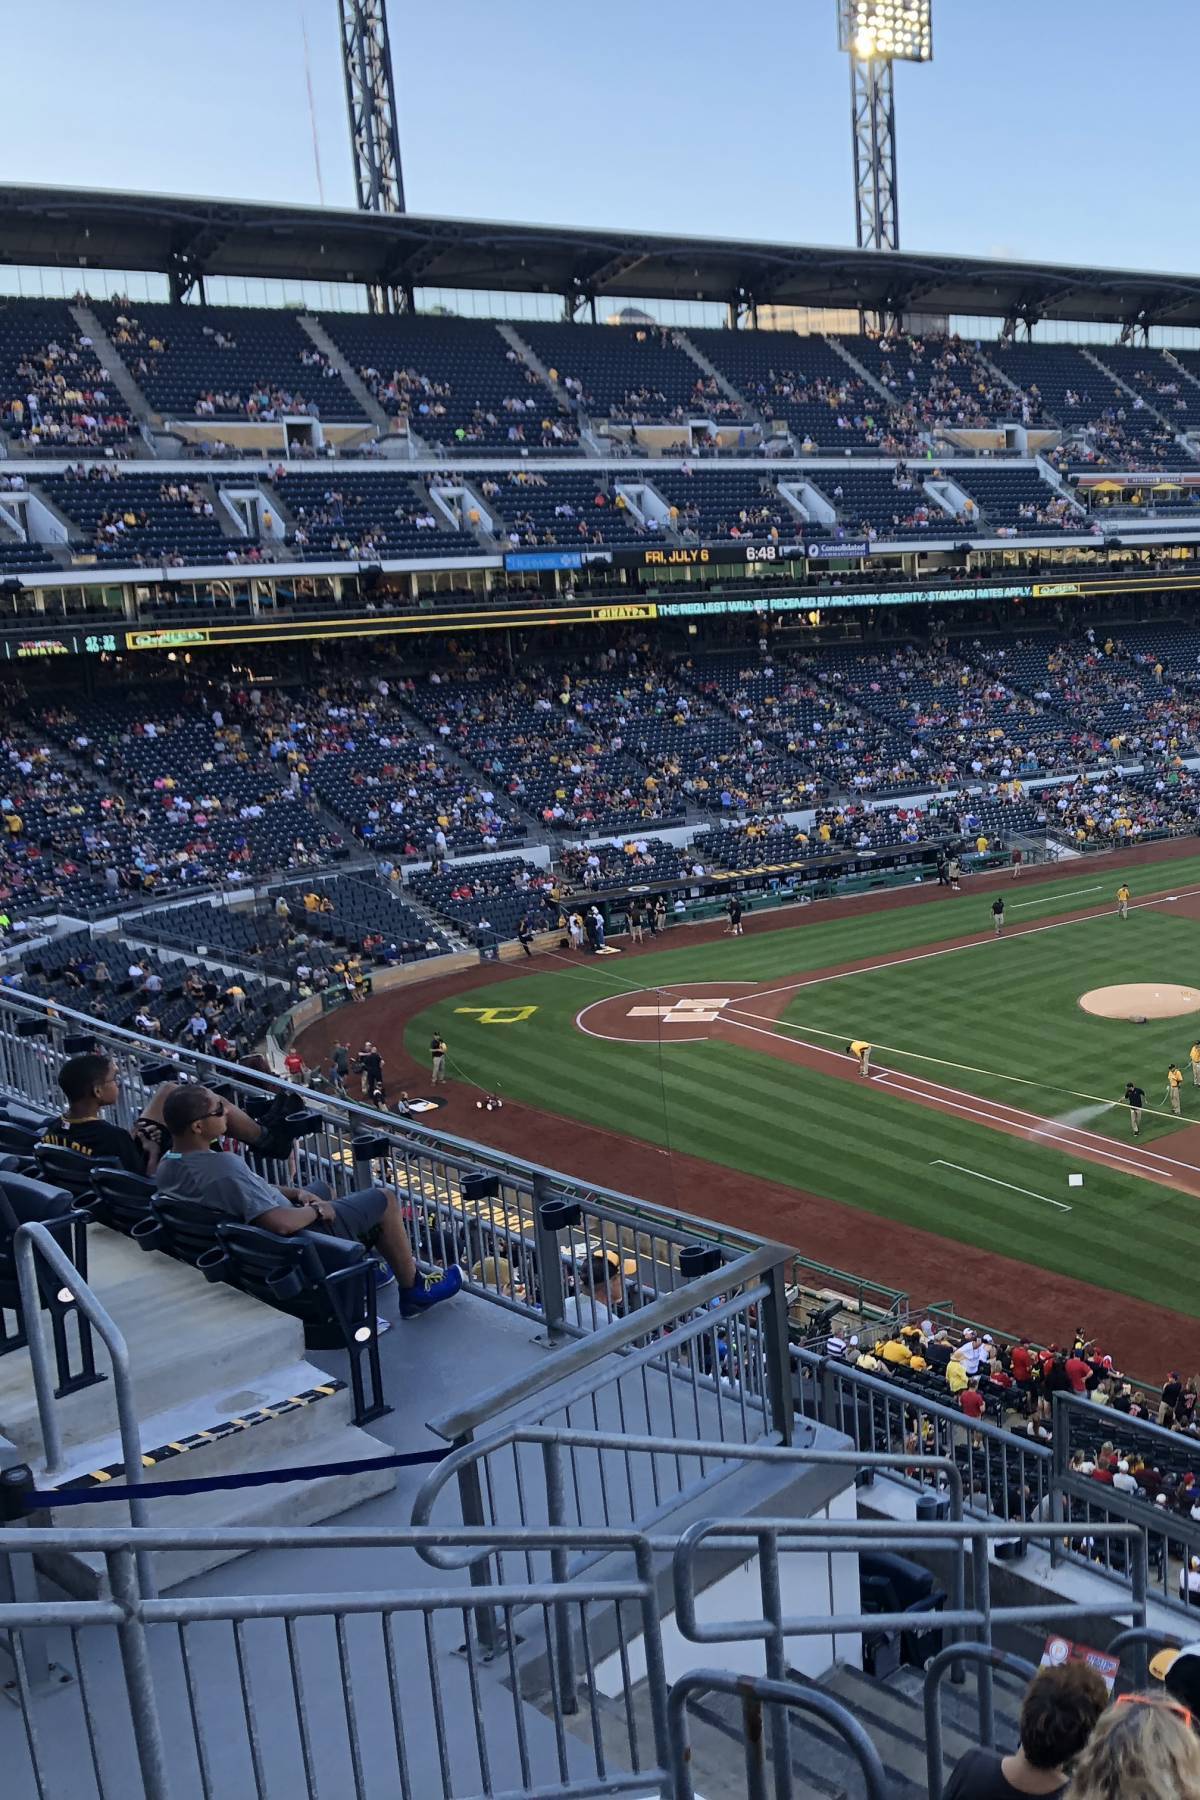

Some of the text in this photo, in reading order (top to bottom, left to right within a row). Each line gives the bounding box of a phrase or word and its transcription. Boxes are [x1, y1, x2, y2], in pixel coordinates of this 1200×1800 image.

[746, 547, 776, 561] 6:48
[821, 543, 866, 552] Consolidated
[645, 548, 709, 564] FRI, JULY 6
[929, 588, 976, 601] STANDARD
[976, 587, 1004, 599] RATES
[1004, 586, 1034, 598] APPLY.
